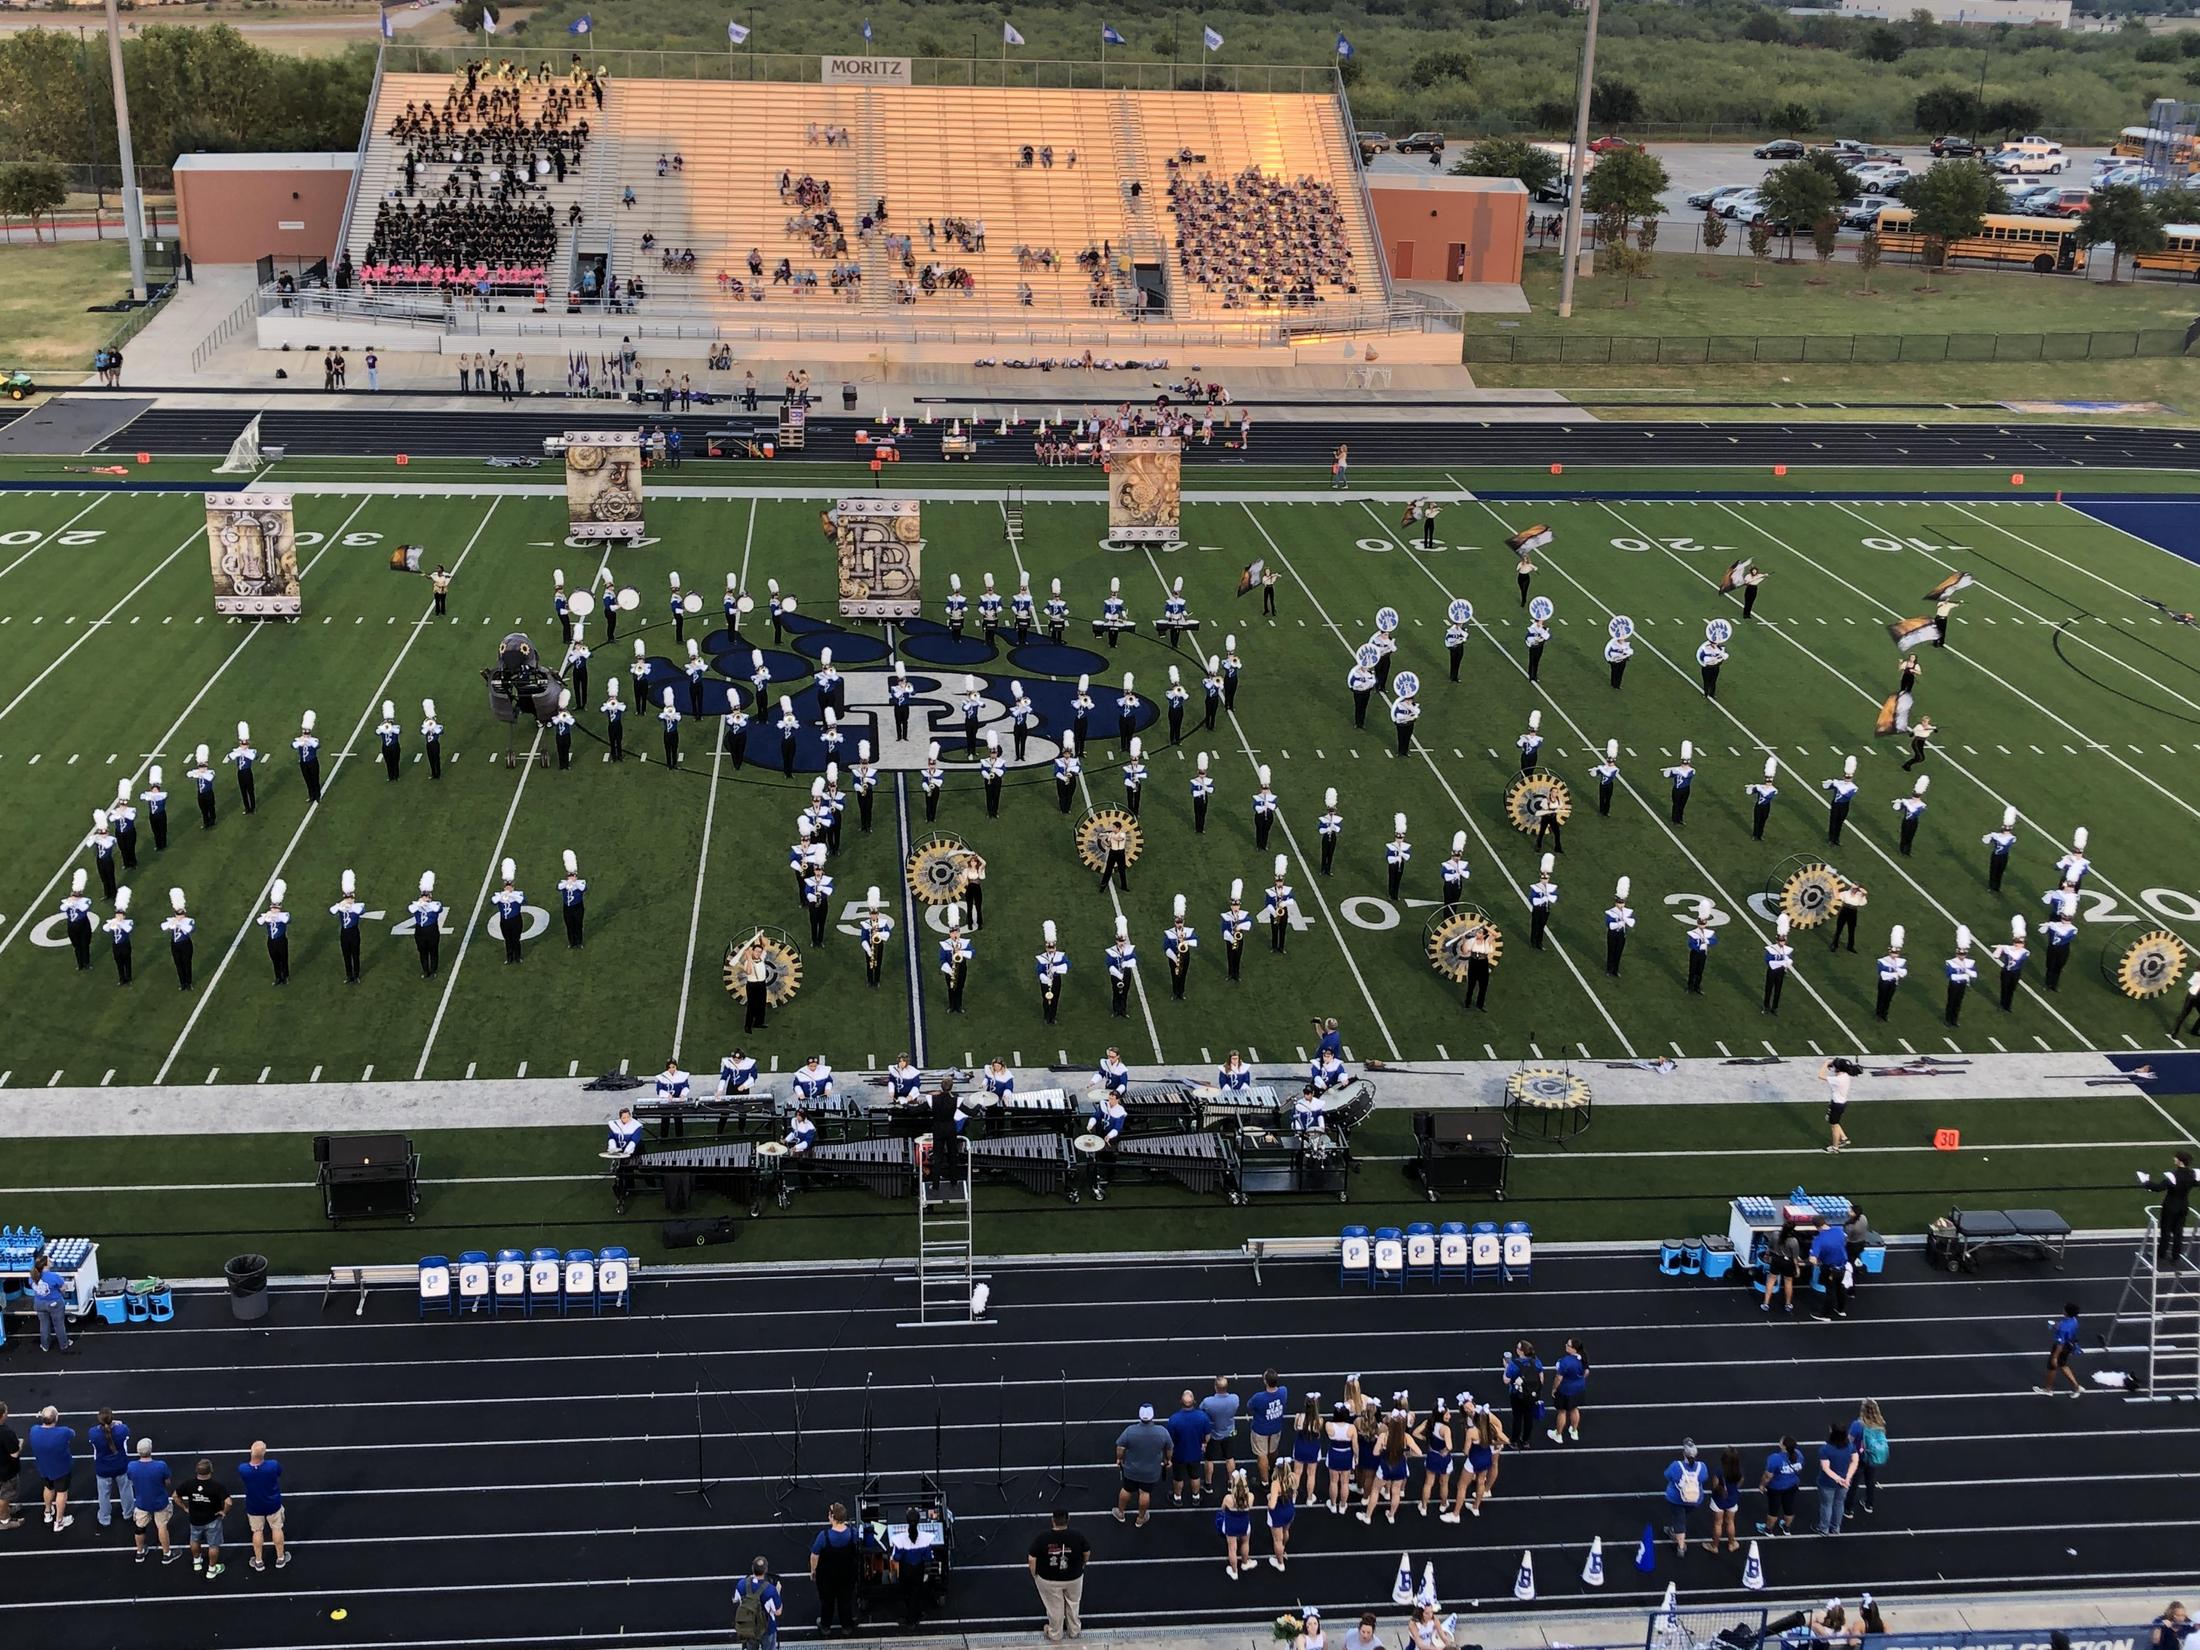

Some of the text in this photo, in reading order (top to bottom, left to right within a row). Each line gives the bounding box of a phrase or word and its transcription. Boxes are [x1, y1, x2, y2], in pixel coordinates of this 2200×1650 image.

[831, 60, 902, 75] MORITZ
[1610, 538, 1705, 552] 20
[1861, 537, 1943, 551] 10
[836, 900, 979, 934] 50
[0, 911, 100, 948] 0
[1941, 1132, 1955, 1146] 30
